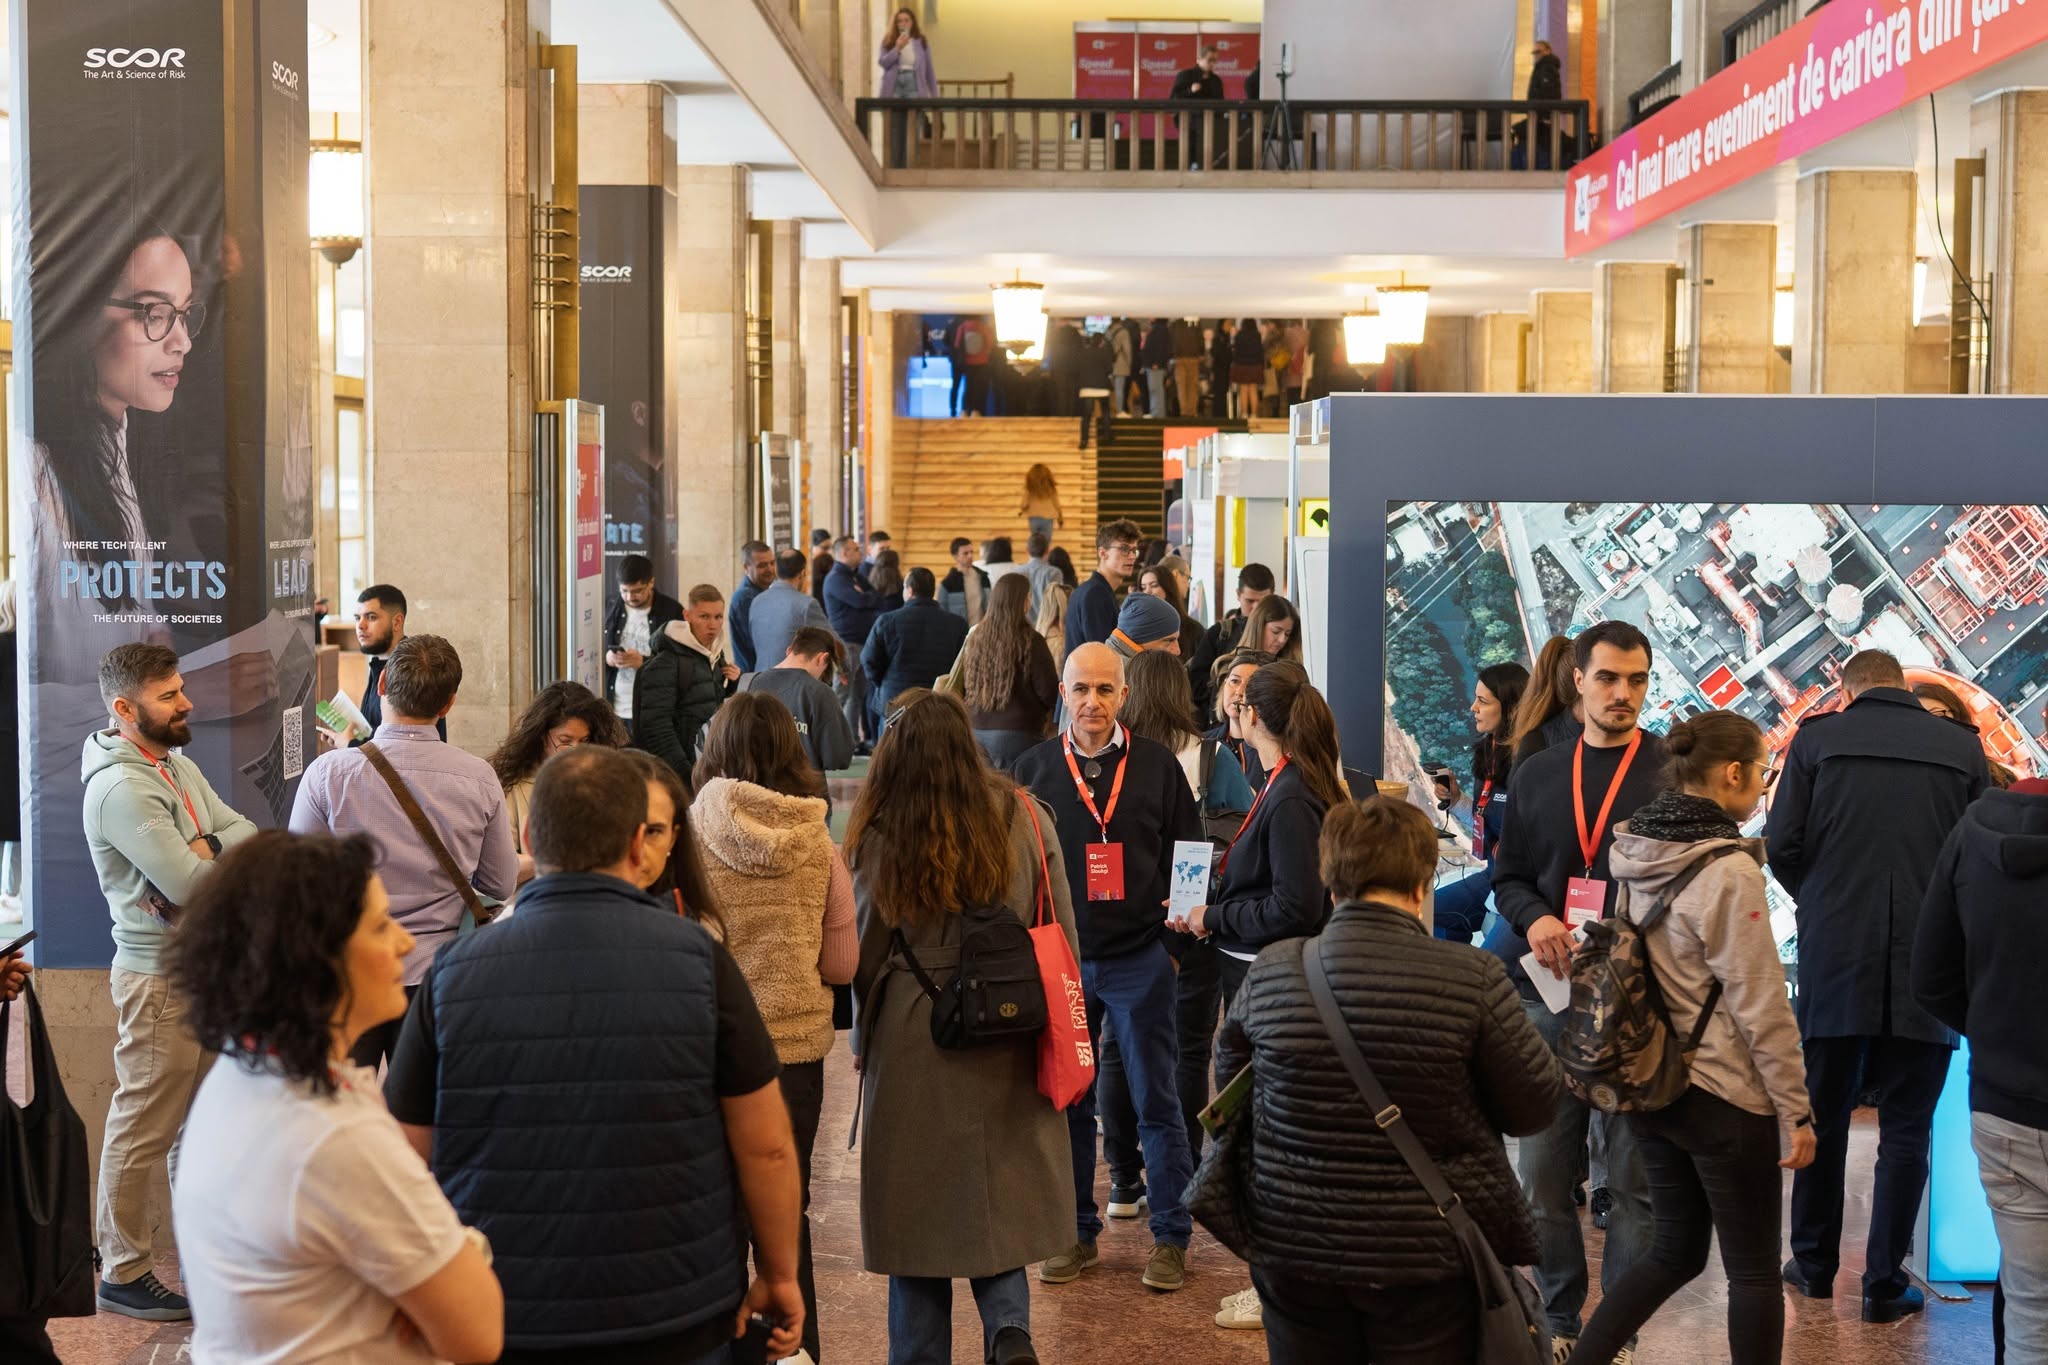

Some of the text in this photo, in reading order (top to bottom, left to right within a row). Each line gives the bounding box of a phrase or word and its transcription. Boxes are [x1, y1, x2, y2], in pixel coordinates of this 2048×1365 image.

[83, 48, 186, 68] SCOR
[83, 70, 186, 79] The Art & Science of Risk
[272, 60, 299, 91] SCOR
[1616, 150, 1637, 211] Cel
[1638, 135, 1664, 200] mai
[1665, 128, 1701, 187] mare
[1703, 62, 1796, 166] eveniment
[1799, 43, 1825, 117] de
[580, 265, 632, 277] SCOR
[63, 541, 166, 550] WHERE TECH TALENT
[59, 560, 227, 600] PROTECTS
[273, 558, 308, 598] LEAD
[93, 614, 222, 624] THE FUTURE OF SOCIETIES
